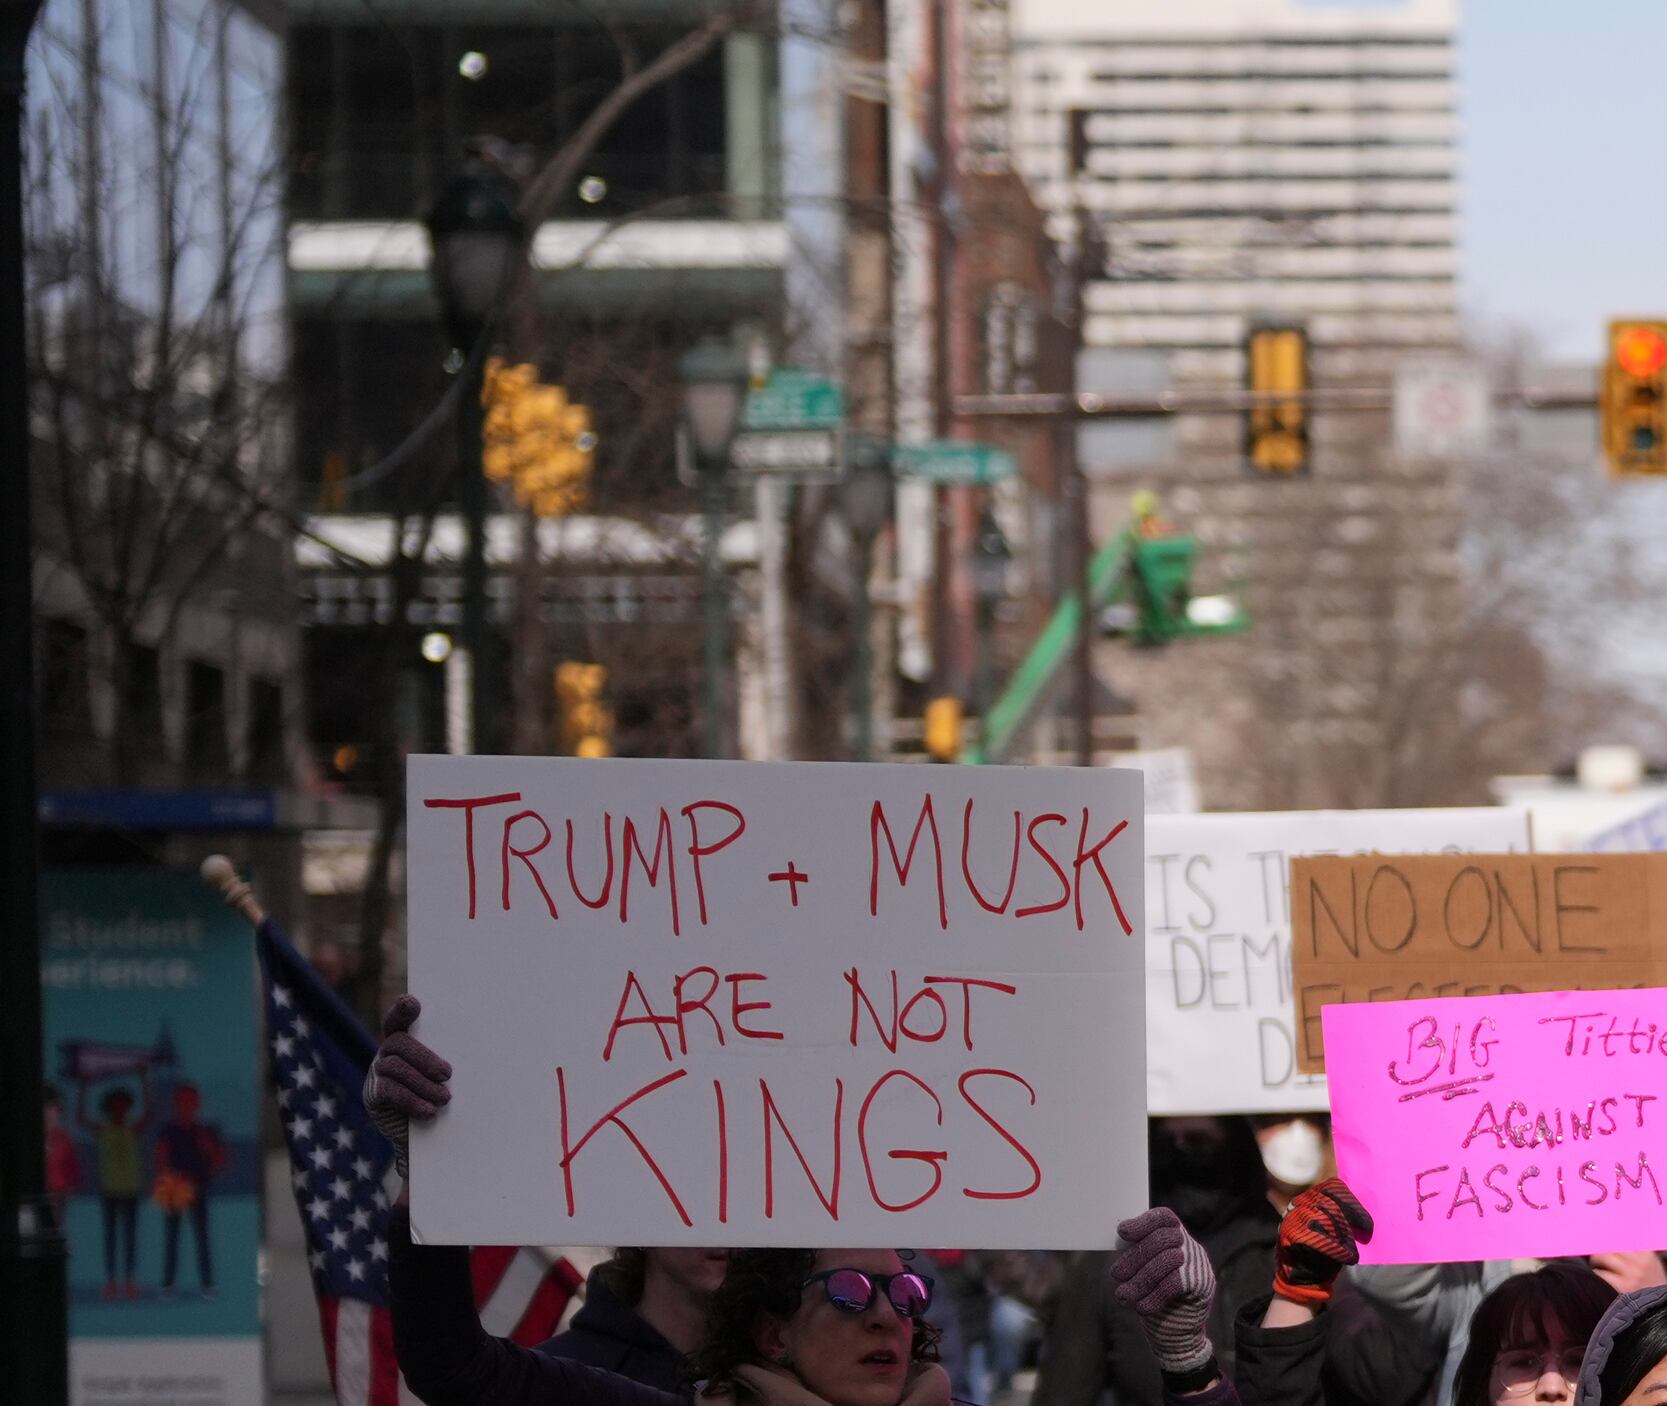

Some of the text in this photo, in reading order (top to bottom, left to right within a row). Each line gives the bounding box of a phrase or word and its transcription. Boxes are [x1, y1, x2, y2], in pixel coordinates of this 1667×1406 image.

[423, 792, 745, 936] TRUMP
[869, 793, 1133, 936] MUSK
[1309, 863, 1418, 959] NO
[1443, 863, 1608, 955] ONE
[603, 966, 1017, 1061] ARE NOT
[1387, 1014, 1500, 1086] BIG
[555, 1066, 1042, 1228] KINGS
[1461, 1092, 1659, 1151] AGAINST
